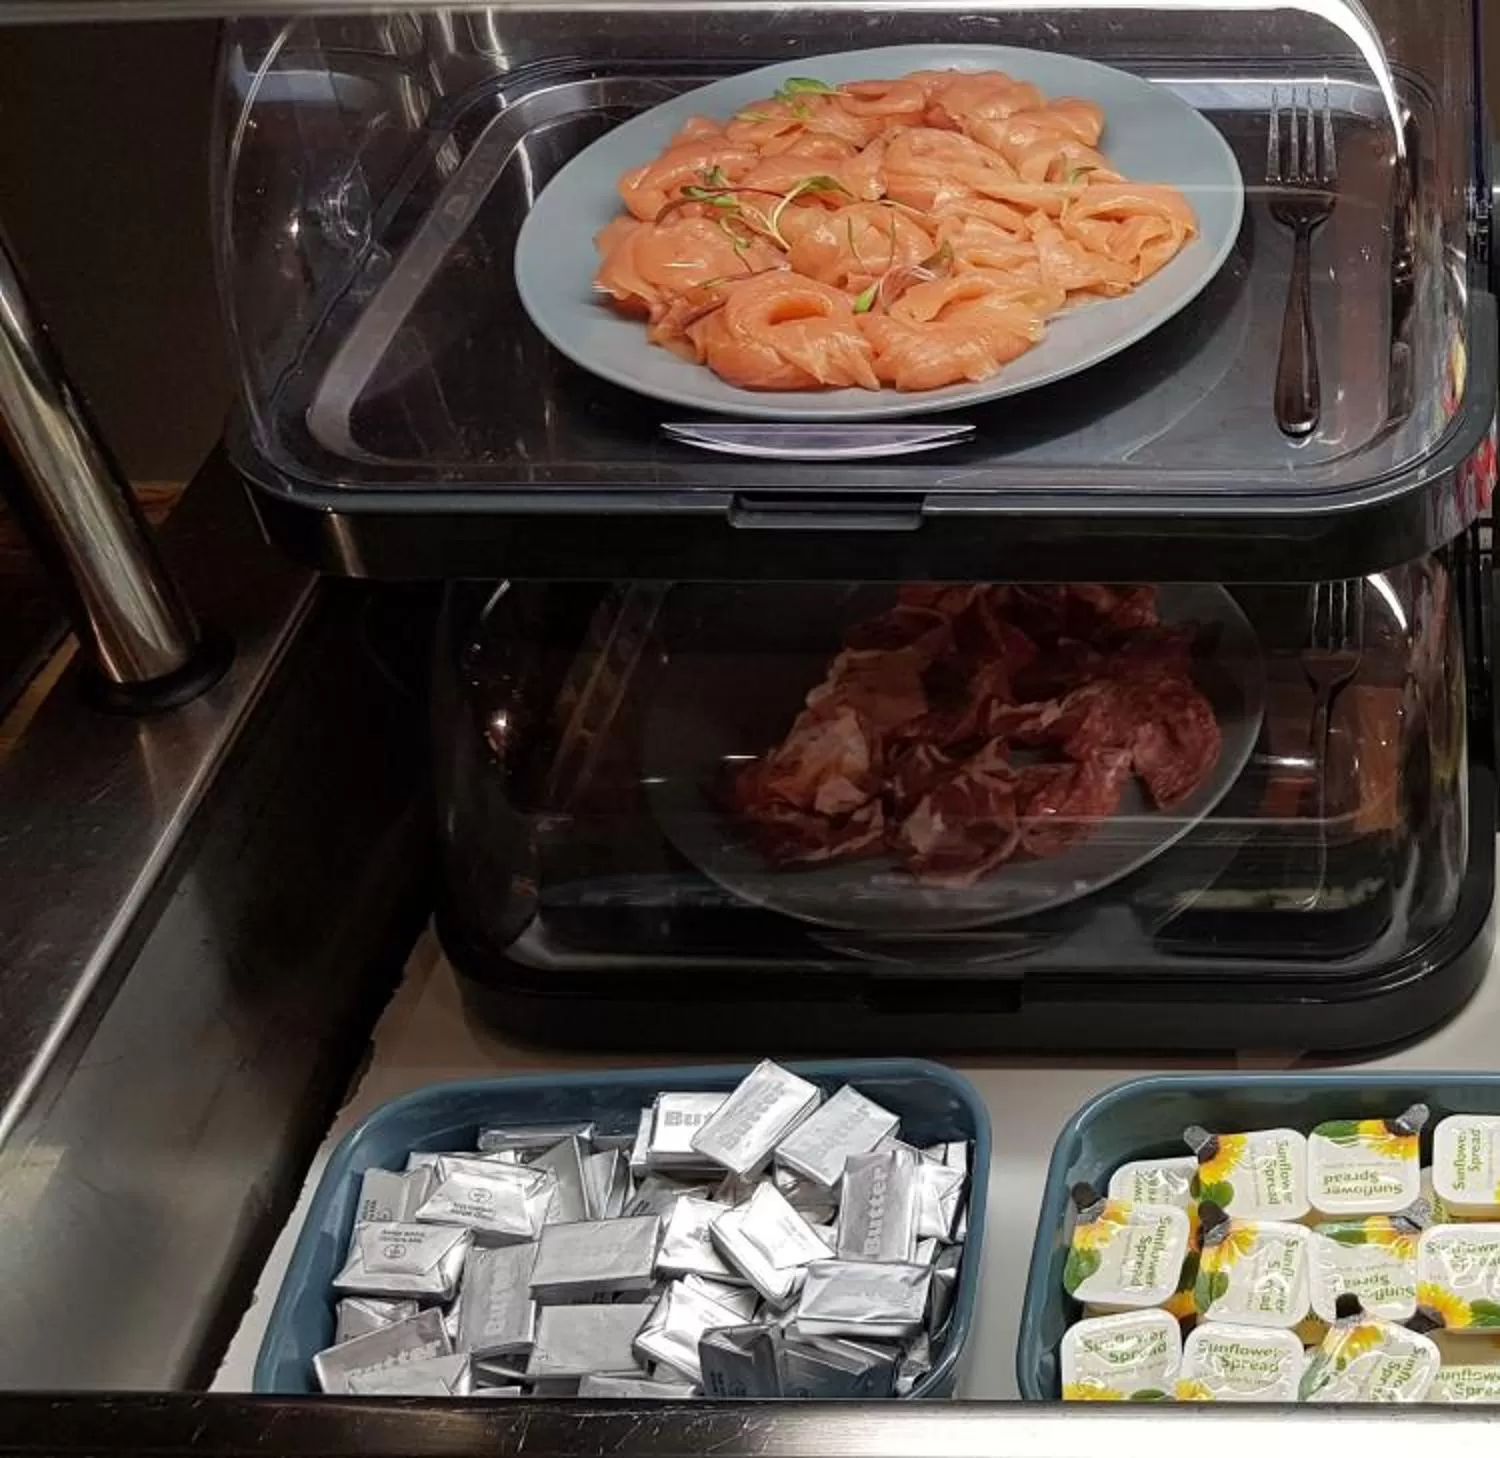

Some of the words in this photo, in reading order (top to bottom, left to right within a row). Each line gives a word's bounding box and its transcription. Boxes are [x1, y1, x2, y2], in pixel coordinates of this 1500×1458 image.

[1276, 1139, 1293, 1205] Sunflower
[1452, 1127, 1468, 1191] Sunflower
[1468, 1129, 1482, 1173] Spread
[1263, 1158, 1281, 1206] Spread
[1324, 1169, 1380, 1184] Spread
[1324, 1184, 1404, 1197] Sunflower
[864, 1166, 889, 1257] Butter
[1131, 1236, 1153, 1287] Spread
[1147, 1215, 1173, 1287] Sunflower
[1199, 1339, 1280, 1359] Sunflower
[1221, 1355, 1280, 1374] Spread
